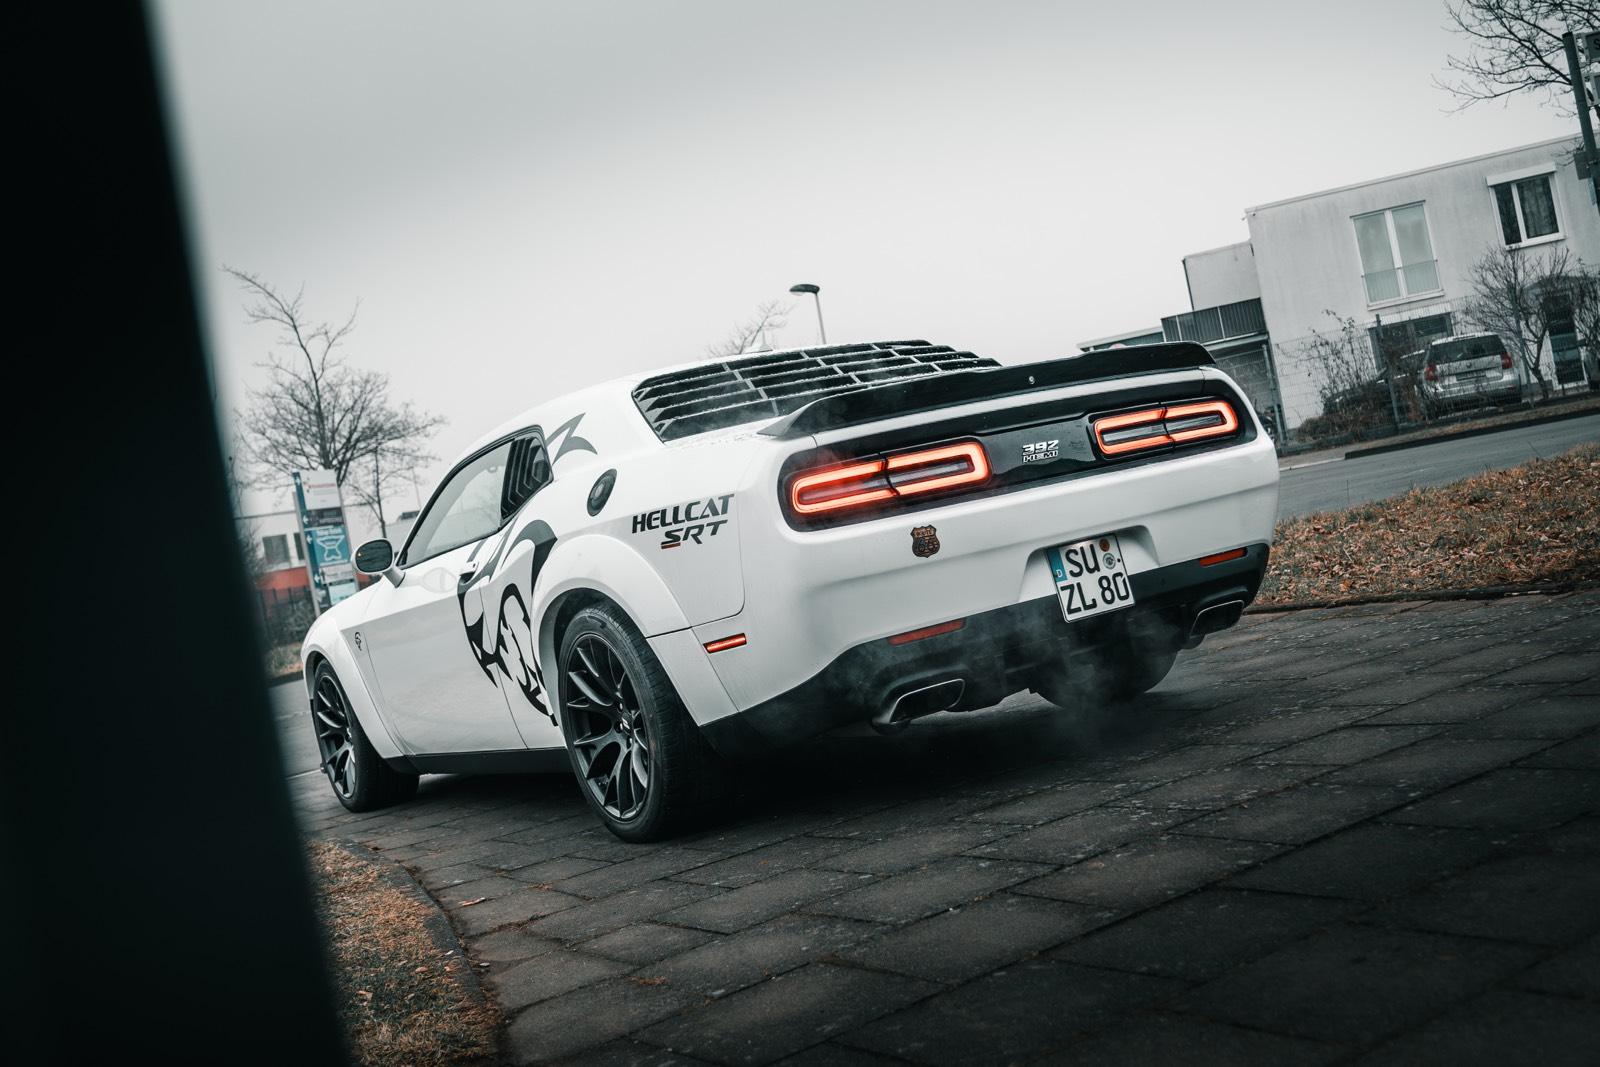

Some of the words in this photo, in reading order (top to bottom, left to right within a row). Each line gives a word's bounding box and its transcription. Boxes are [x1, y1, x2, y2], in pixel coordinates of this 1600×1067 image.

[1022, 440, 1059, 456] 392
[631, 493, 735, 534] HELLCAT
[660, 519, 729, 546] SRT
[1055, 568, 1063, 578] D
[1065, 543, 1101, 578] SU
[1060, 582, 1098, 615] ZL
[1097, 571, 1130, 605] 80
